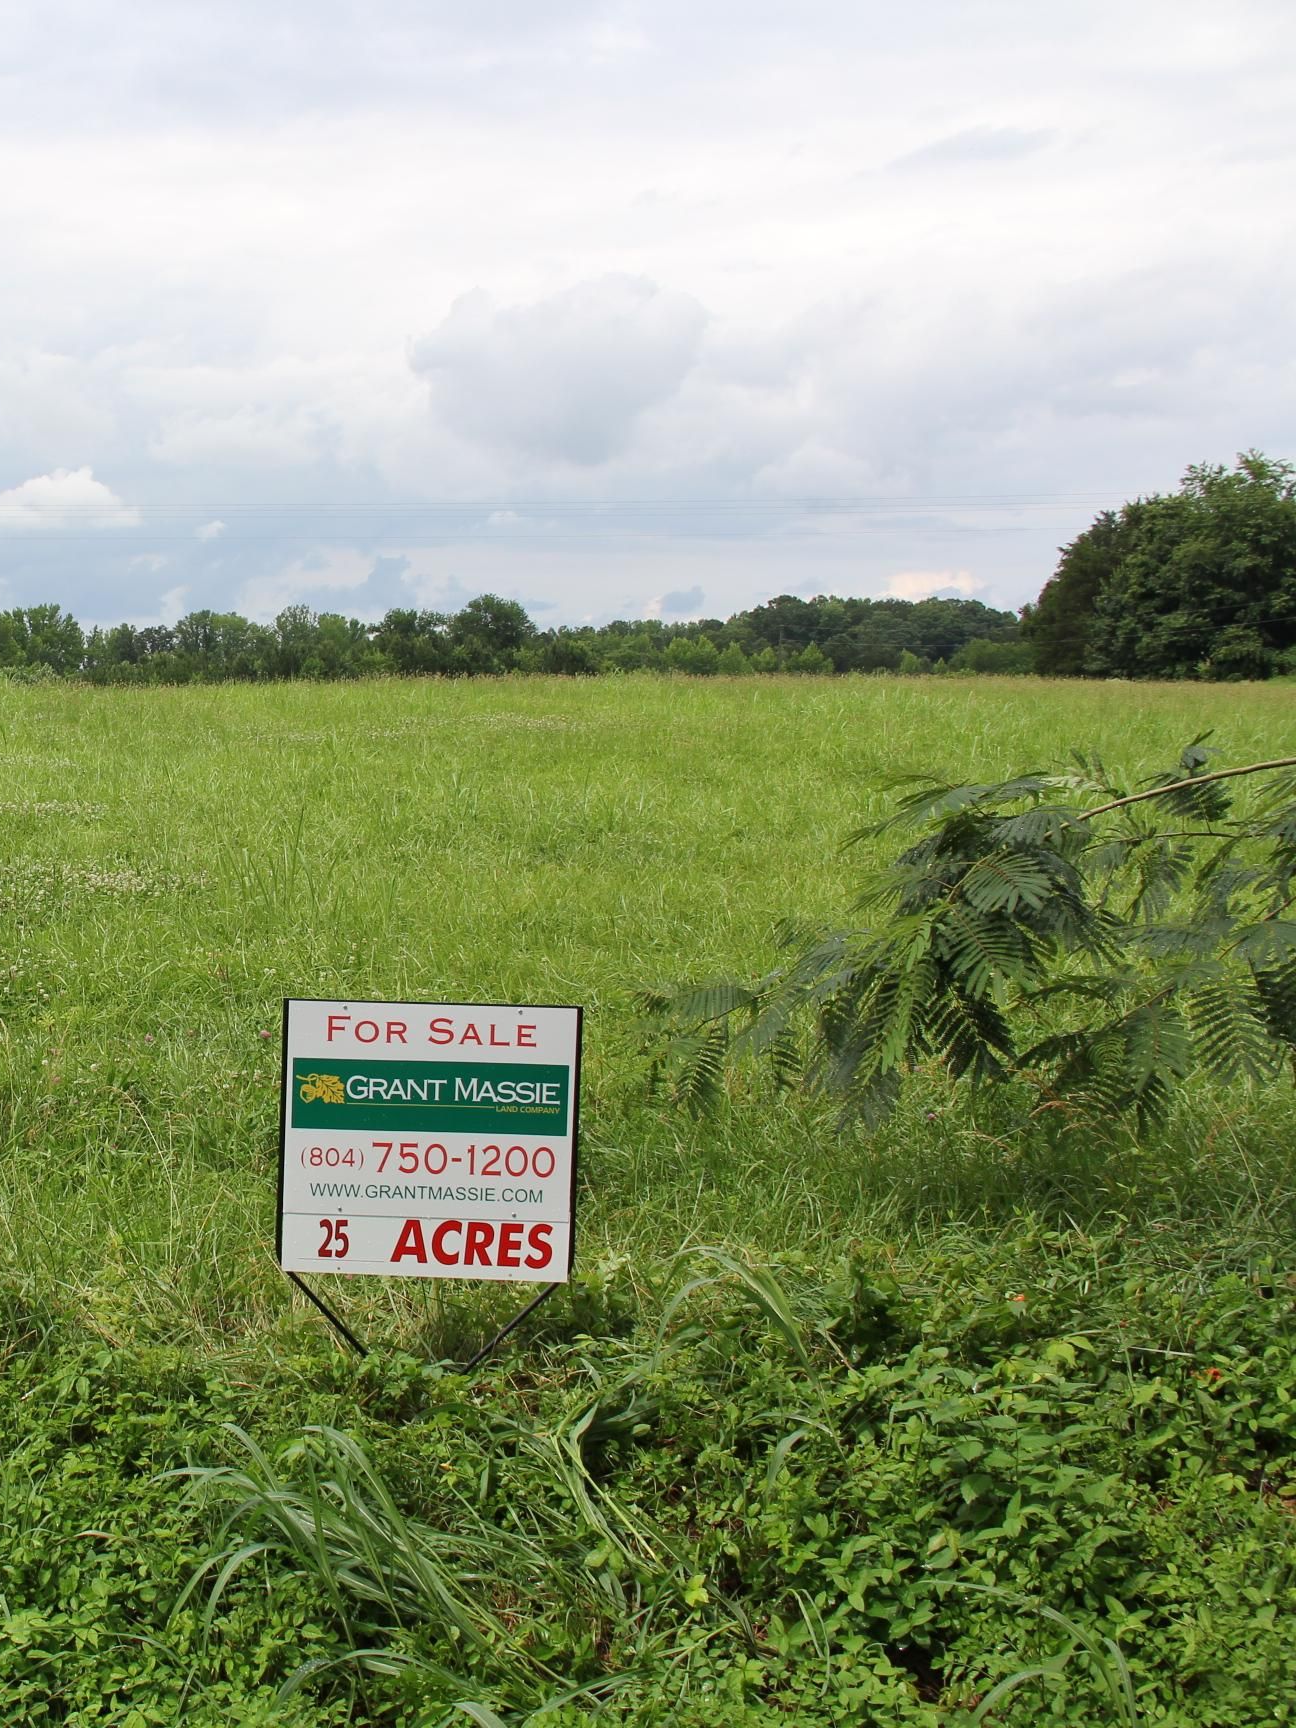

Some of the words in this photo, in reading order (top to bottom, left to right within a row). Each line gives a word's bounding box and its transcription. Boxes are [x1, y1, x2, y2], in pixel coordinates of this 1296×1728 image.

[345, 1074, 447, 1101] GRANT
[454, 1077, 561, 1105] MASSIE
[495, 1105, 519, 1114] LAND
[519, 1106, 561, 1115] COMPANY
[300, 1147, 365, 1170] (804)
[371, 1142, 556, 1178] 750-1200
[309, 1183, 544, 1203] WWW.GRANTMASSIE.COM
[317, 1219, 350, 1258] 25
[389, 1219, 554, 1270] ACRES
